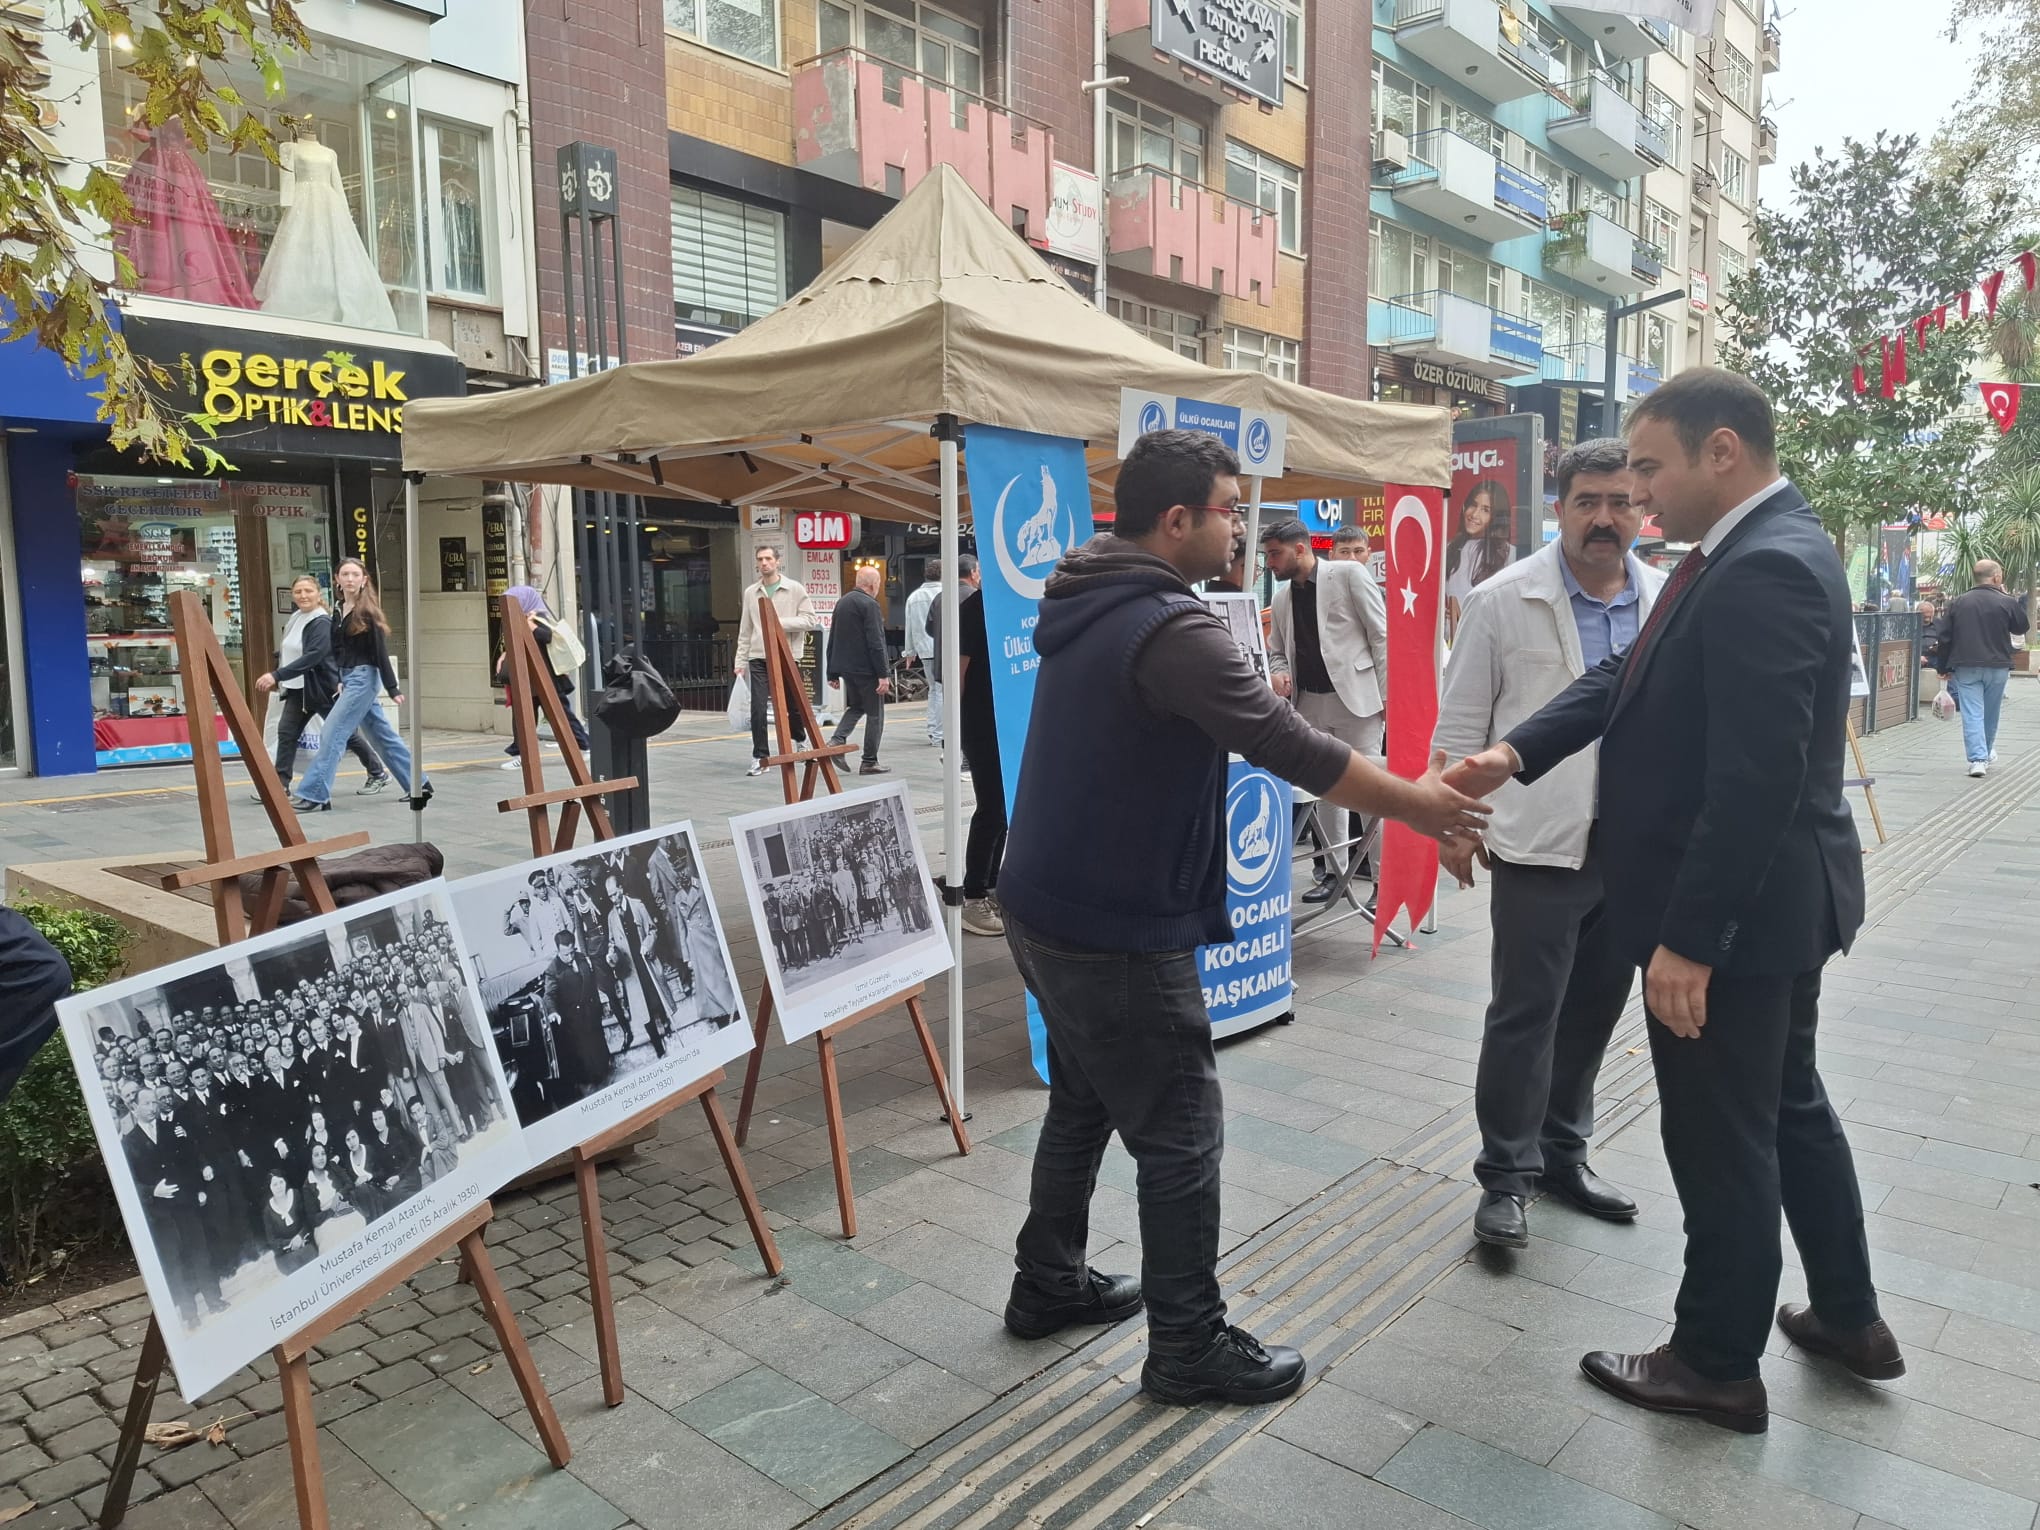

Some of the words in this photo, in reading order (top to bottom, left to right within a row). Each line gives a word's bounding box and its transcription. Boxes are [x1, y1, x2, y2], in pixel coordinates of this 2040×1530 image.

[1205, 5, 1247, 43] TATTOO
[1200, 39, 1251, 80] PIERCING
[1223, 35, 1231, 50] &
[1072, 198, 1096, 219] STUDY
[202, 350, 408, 401] gerçek
[1414, 359, 1444, 385] ÖZER
[1446, 366, 1489, 396] ÖZTÜRK
[1179, 412, 1200, 425] ÜLKÜ
[1201, 417, 1236, 430] OCAKLARI
[798, 511, 845, 543] BİM
[807, 551, 834, 564] EMLAK
[812, 569, 830, 580] 0533
[1004, 635, 1031, 659] Ülkü
[1204, 924, 1285, 972] KOCAELİ
[580, 1094, 613, 1115] Mustafa
[613, 1080, 637, 1099] Kemal
[621, 1099, 634, 1112] (25
[657, 1076, 675, 1092] 1930)
[319, 1242, 364, 1275] Mustafa
[364, 1218, 397, 1247] Kemal
[398, 1194, 436, 1226] Atatürk,
[269, 1290, 320, 1332] İstanbul
[320, 1249, 383, 1298] Üniversitesi
[383, 1223, 420, 1256] Ziyareti
[419, 1216, 433, 1236] (15
[432, 1200, 459, 1221] Aralık
[458, 1182, 480, 1204] 1930)
